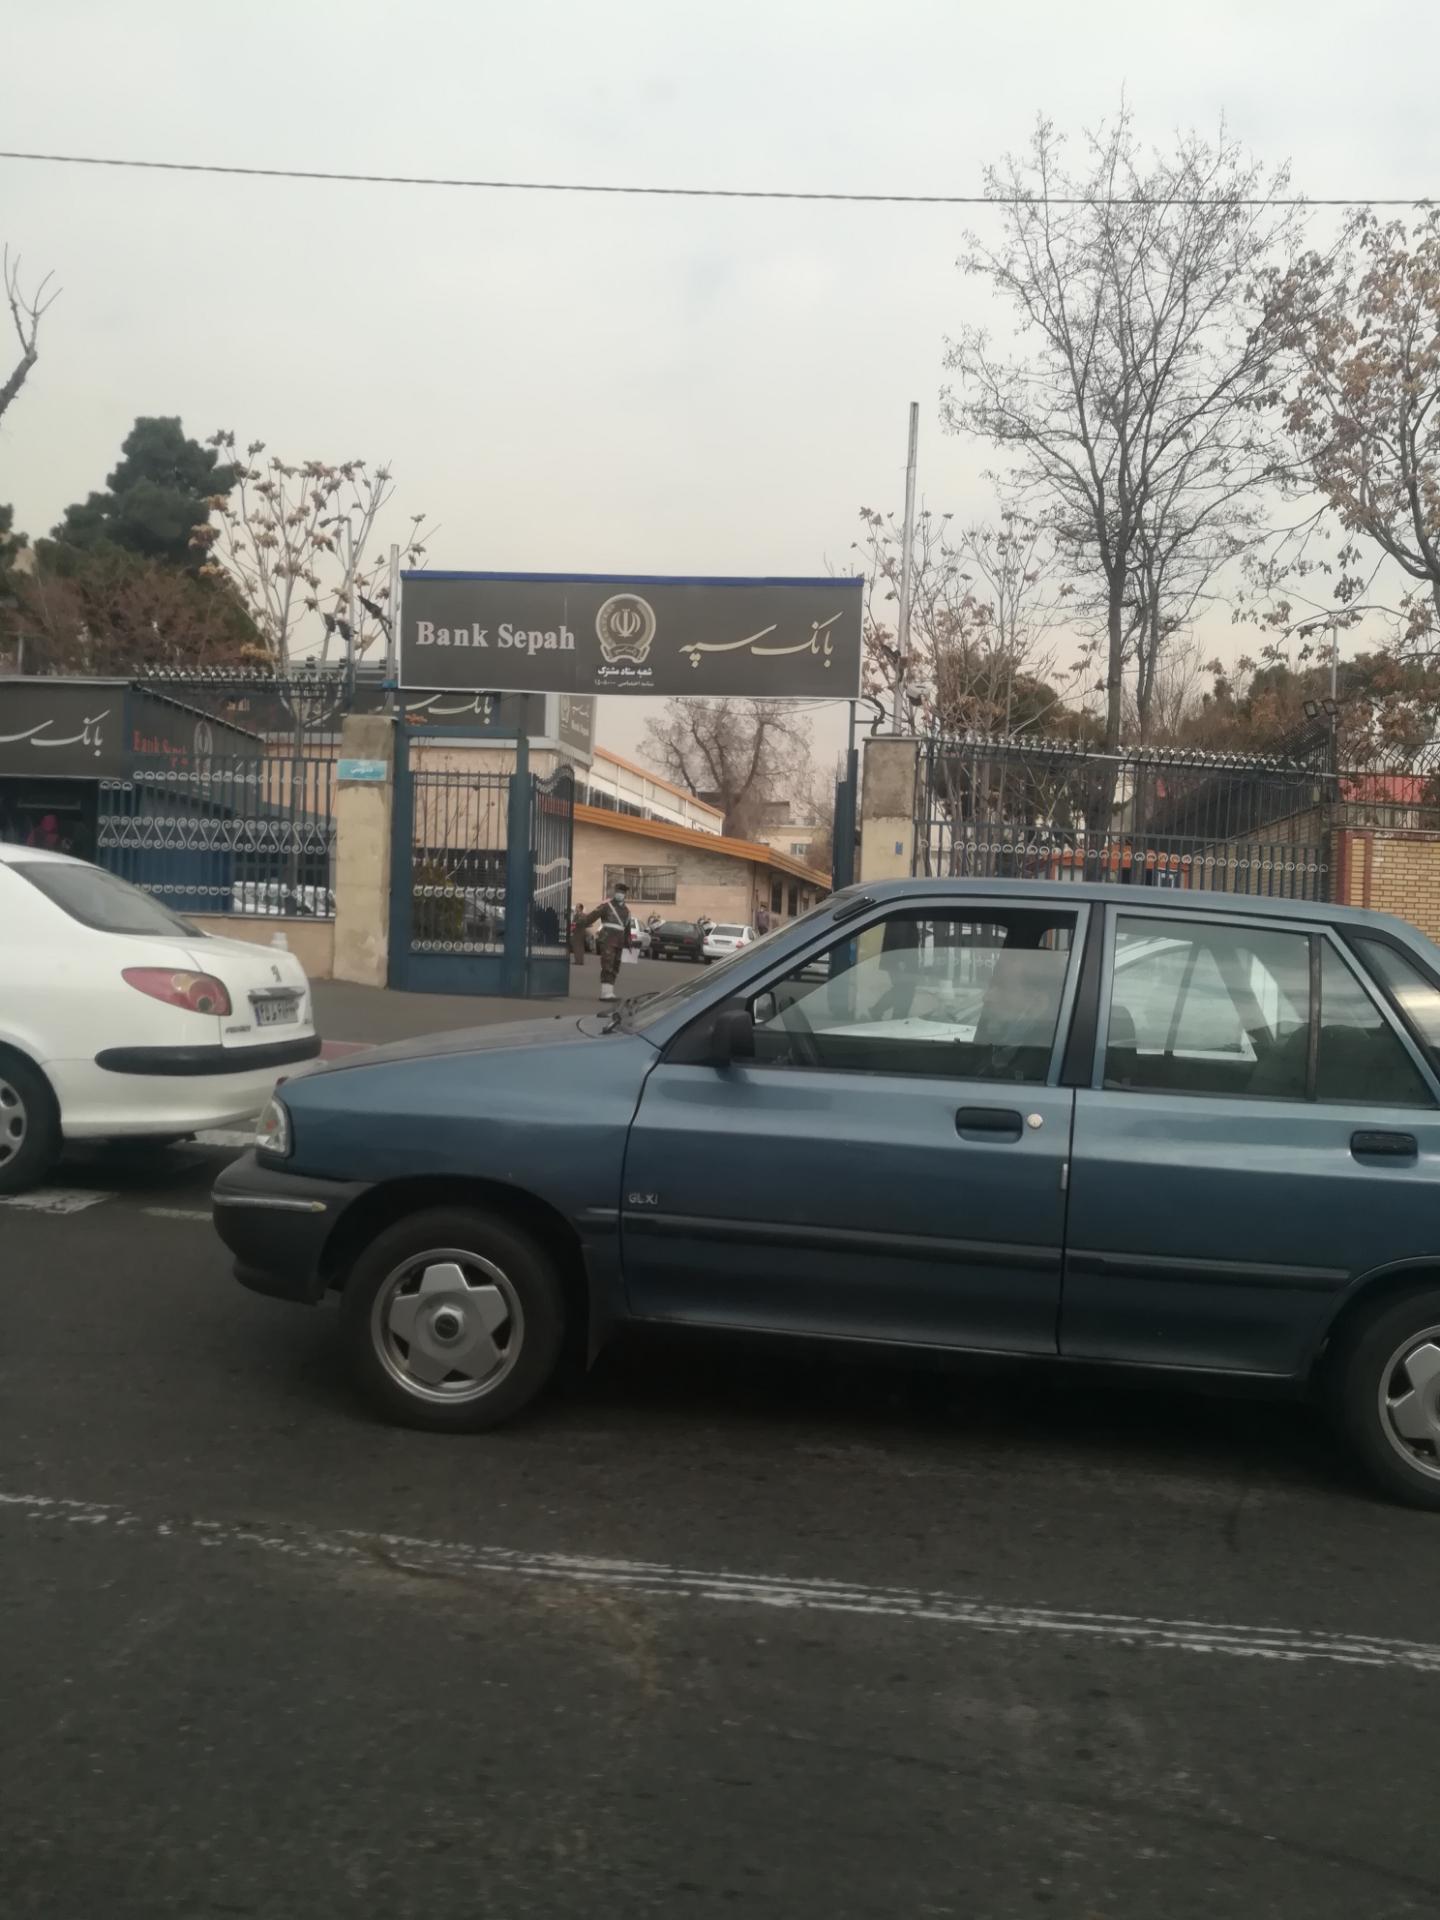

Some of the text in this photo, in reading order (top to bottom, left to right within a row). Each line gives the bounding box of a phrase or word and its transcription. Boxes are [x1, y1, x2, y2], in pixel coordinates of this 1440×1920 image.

[416, 621, 576, 656] Bank Sepah
[678, 611, 843, 668] بانک سپه
[597, 666, 653, 679] شعبه ستاد مشترک
[30, 709, 110, 757] بانک
